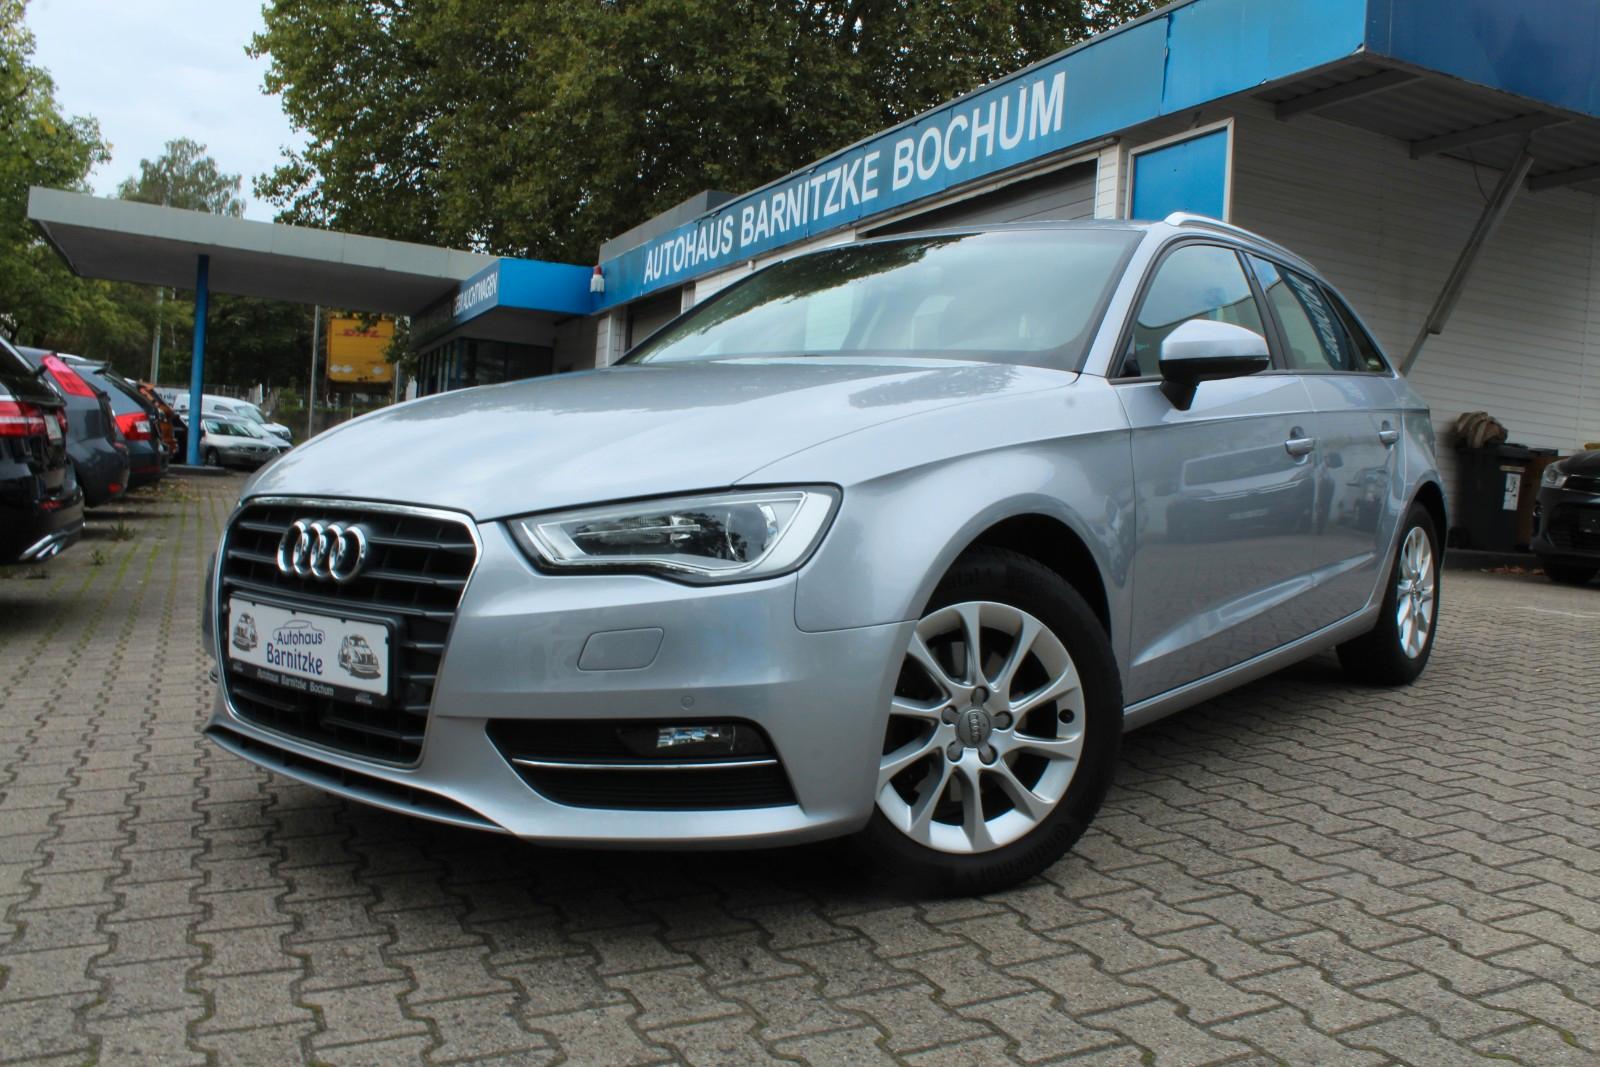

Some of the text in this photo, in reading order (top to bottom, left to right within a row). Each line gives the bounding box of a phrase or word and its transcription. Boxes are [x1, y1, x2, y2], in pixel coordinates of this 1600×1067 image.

[643, 71, 1066, 285] AUTOHAUS BARNITZKE BOCHUM
[276, 631, 323, 645] Autohaus
[267, 642, 323, 676] Barnitzke
[309, 682, 335, 697] Bochum
